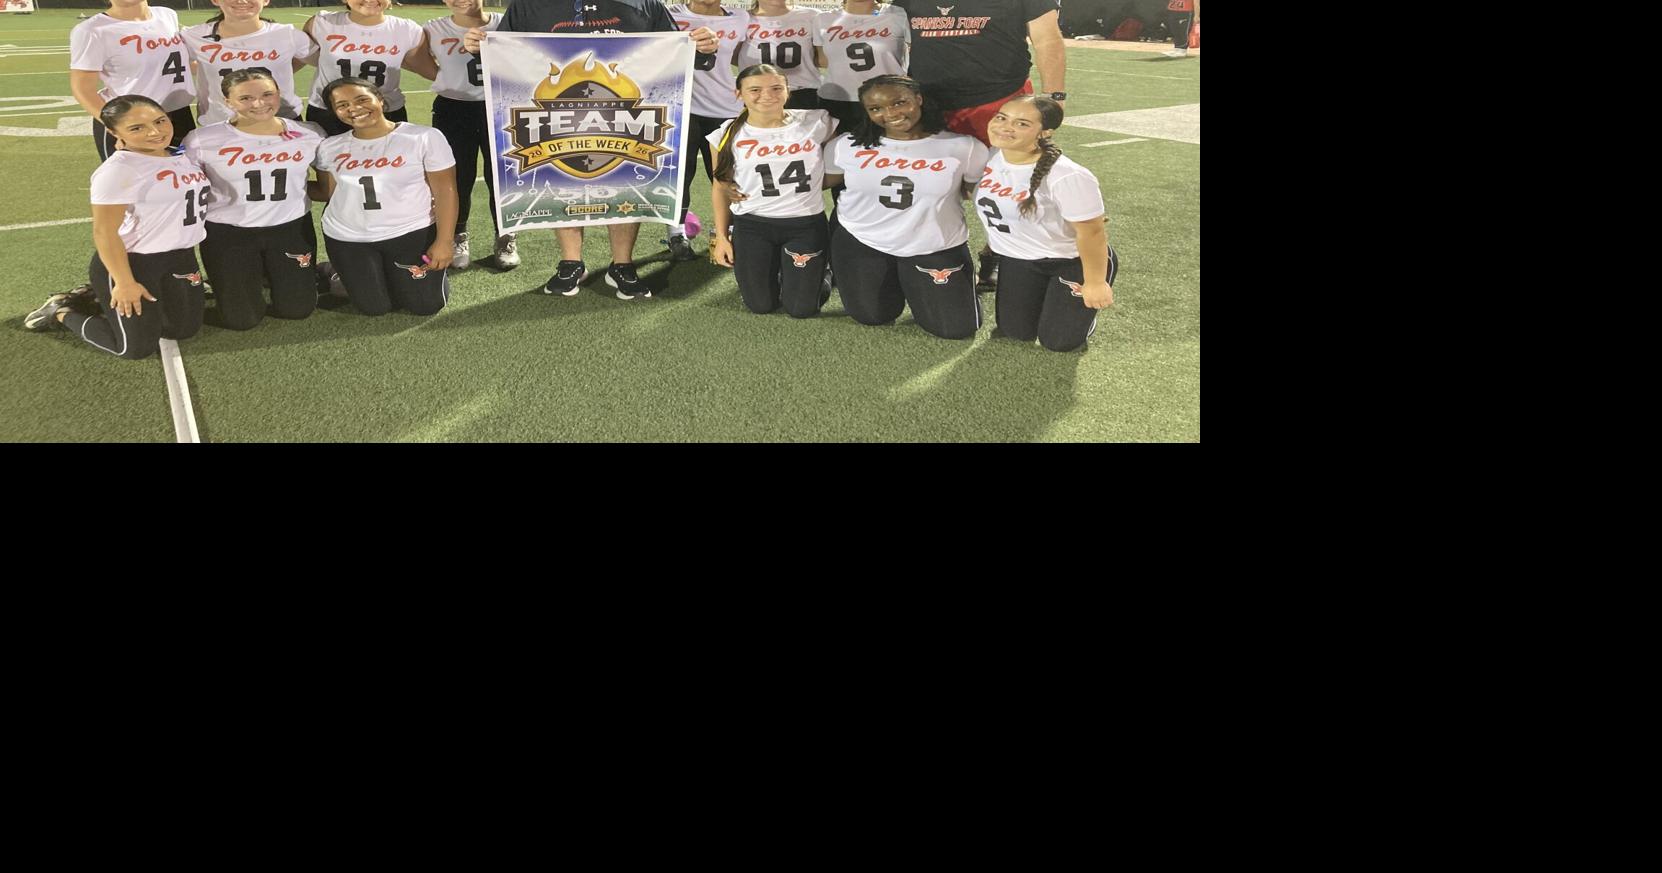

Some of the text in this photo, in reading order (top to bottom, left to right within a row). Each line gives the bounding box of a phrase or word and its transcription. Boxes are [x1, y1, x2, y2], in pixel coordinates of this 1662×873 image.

[747, 24, 808, 40] Toros
[911, 16, 991, 29] SPANISH FORT
[827, 25, 891, 42] Toros
[120, 34, 186, 54] Toro
[201, 44, 280, 64] Toros
[326, 35, 400, 56] Toros
[757, 41, 802, 69] 10
[846, 42, 876, 72] 9
[162, 51, 186, 83] 4
[336, 59, 387, 88] 18
[520, 110, 656, 144] TEAM
[529, 149, 543, 159] 20
[548, 139, 631, 152] OF THE WEEK
[736, 139, 815, 159] Toros
[218, 147, 304, 166] Toros
[334, 153, 406, 172] Toros
[855, 149, 946, 171] Toros
[156, 170, 208, 189] Toro
[244, 168, 288, 201] 11
[755, 160, 811, 197] 14
[359, 176, 382, 210] 1
[879, 175, 914, 210] 3
[570, 205, 604, 214] SCORE
[978, 197, 1011, 233] 2
